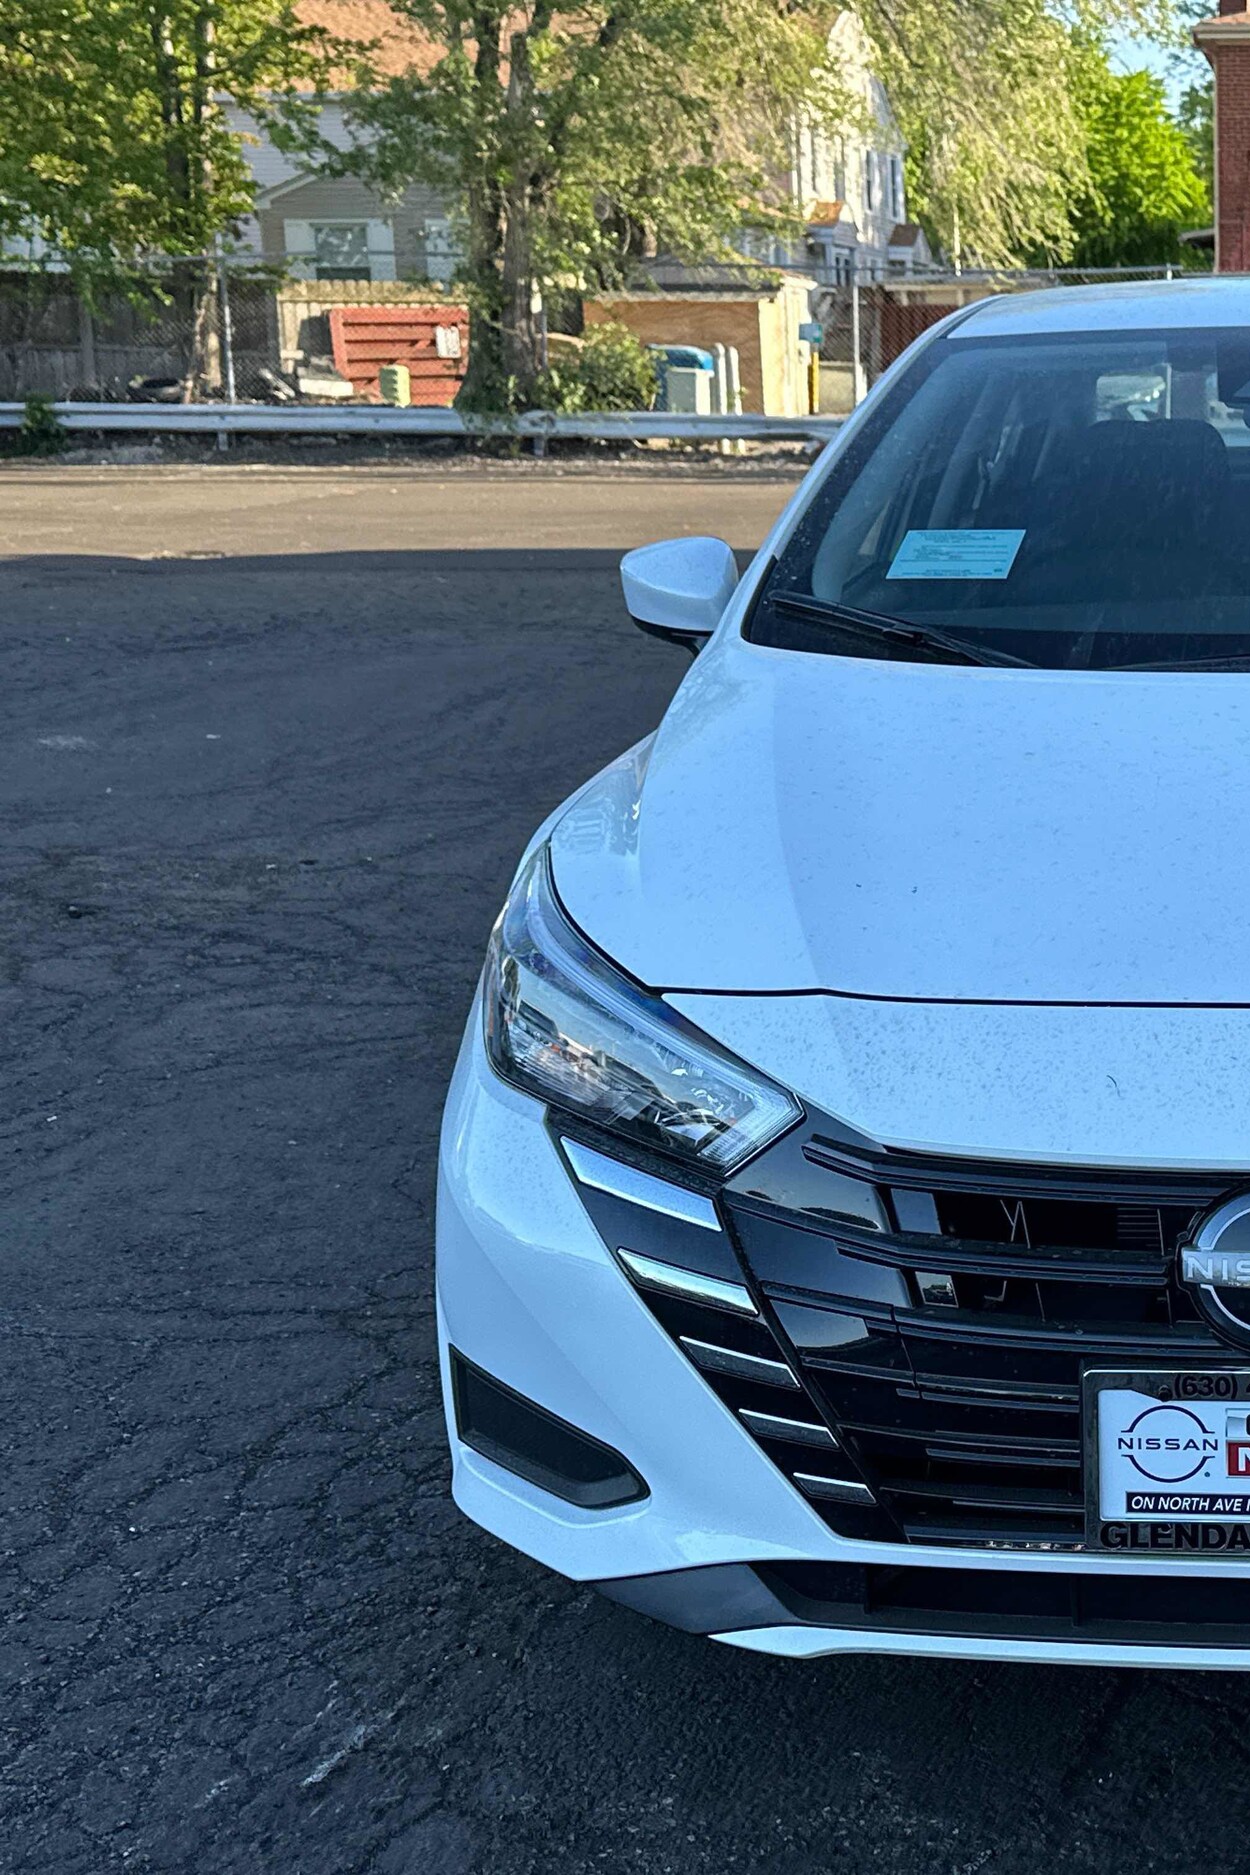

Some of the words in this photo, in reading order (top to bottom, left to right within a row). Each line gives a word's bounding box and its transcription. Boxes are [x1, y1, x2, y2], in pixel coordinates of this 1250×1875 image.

[1173, 1374, 1239, 1399] (630)
[1117, 1436, 1219, 1452] NISSAN
[1131, 1495, 1155, 1511] ON
[1157, 1496, 1210, 1512] NORTH
[1212, 1498, 1243, 1512] AVE
